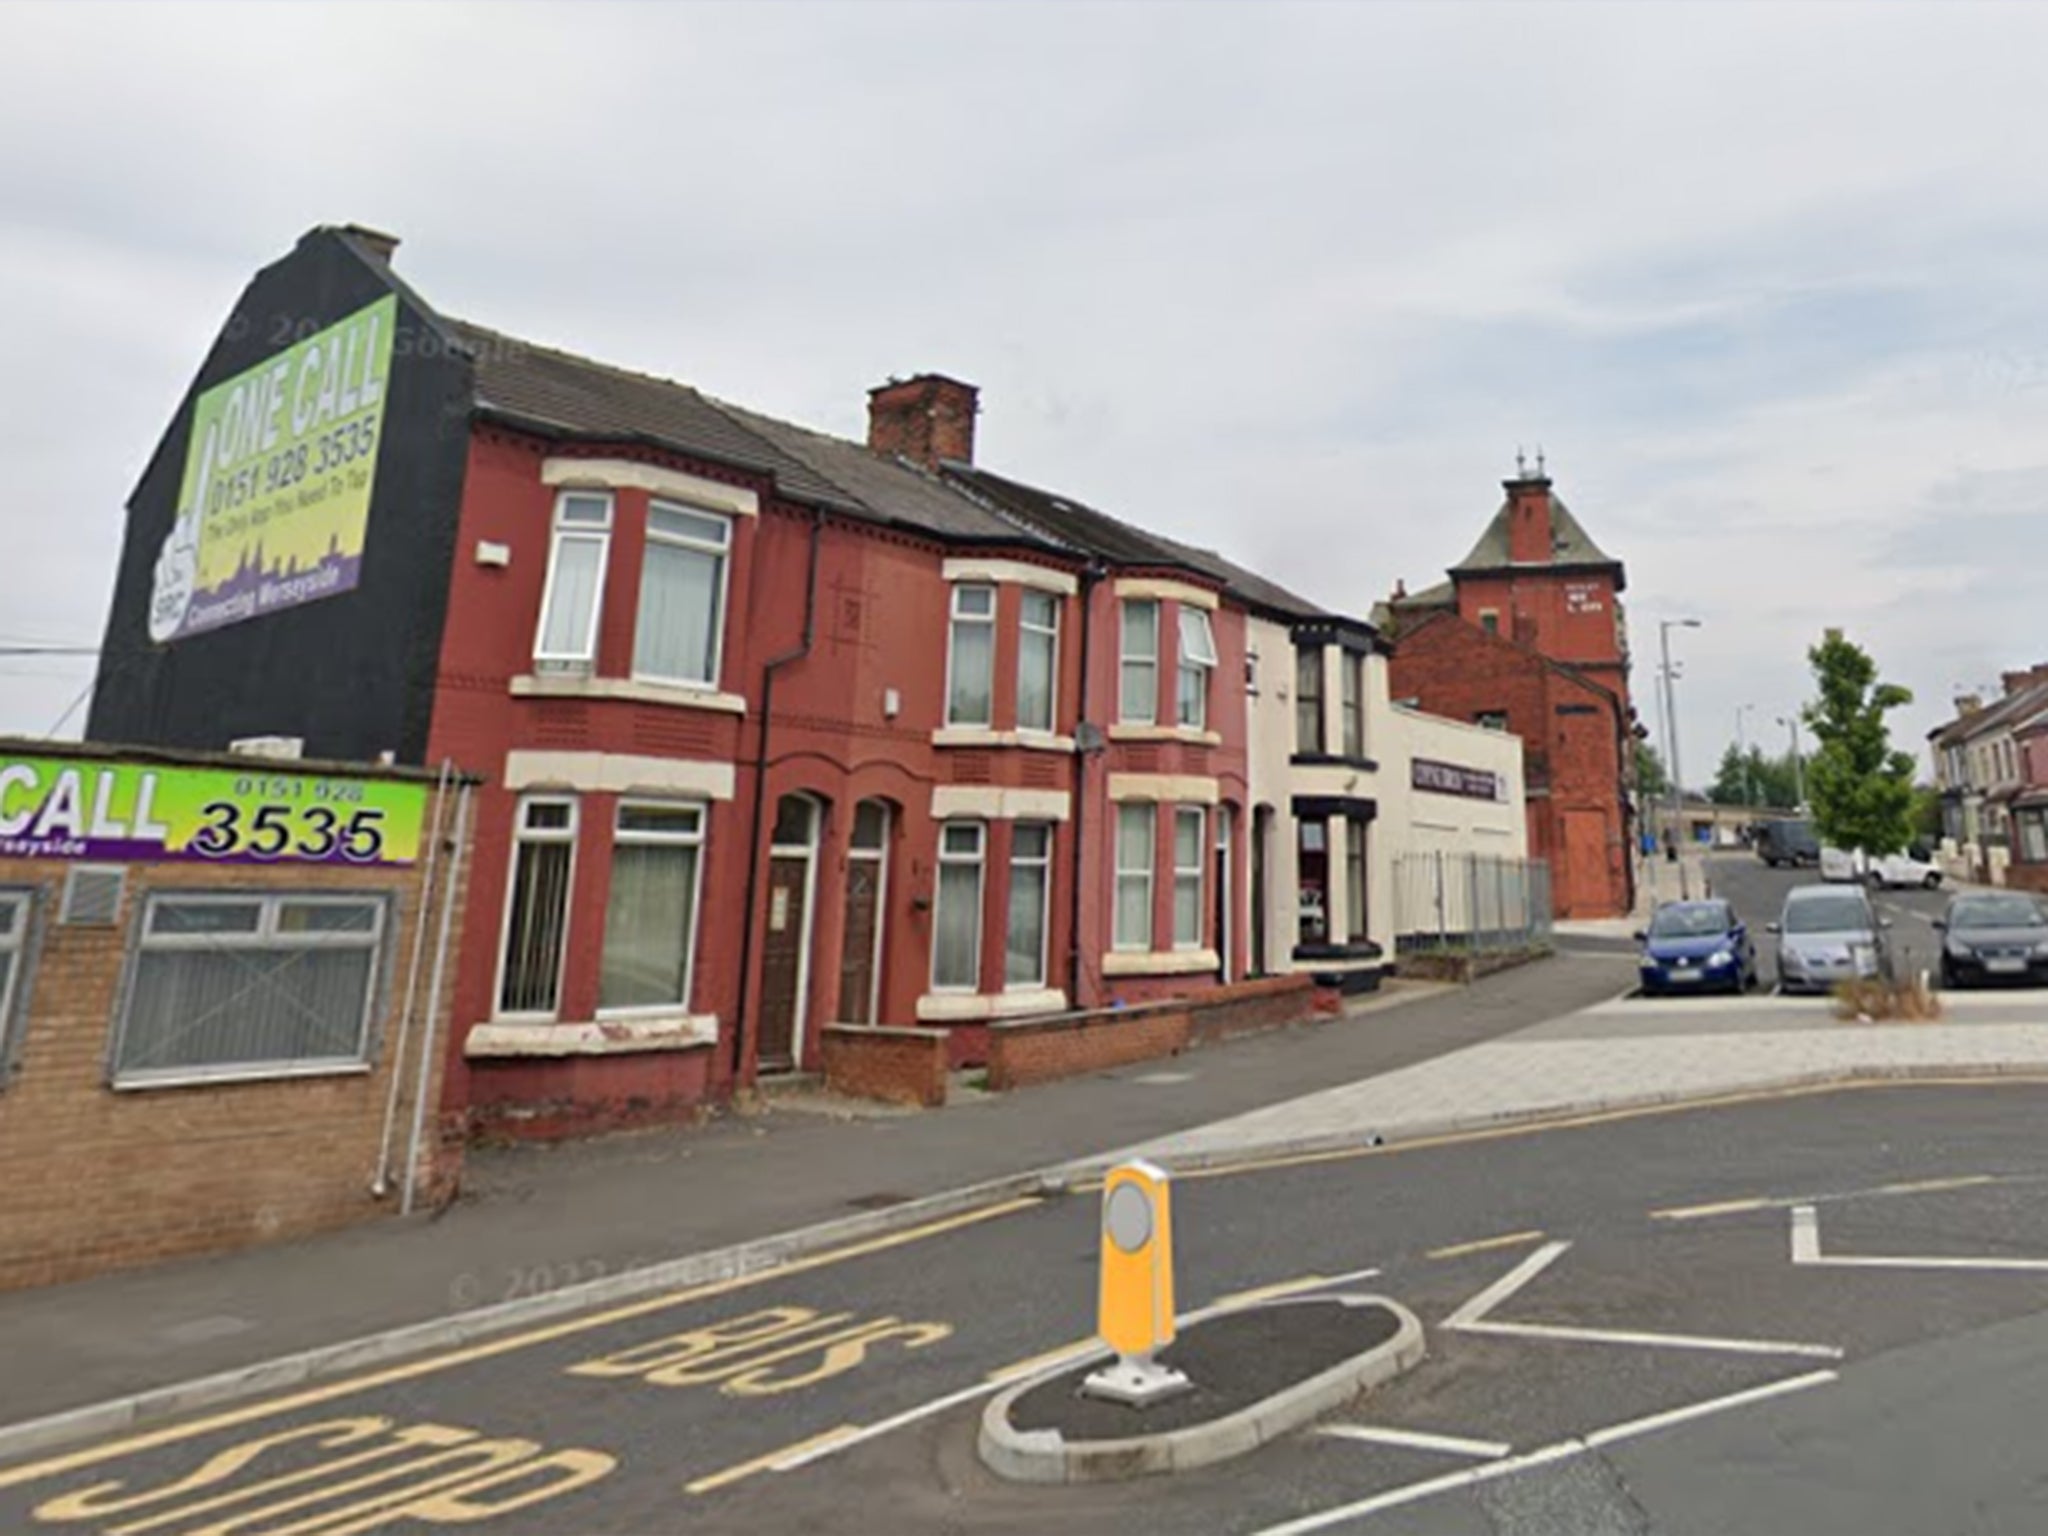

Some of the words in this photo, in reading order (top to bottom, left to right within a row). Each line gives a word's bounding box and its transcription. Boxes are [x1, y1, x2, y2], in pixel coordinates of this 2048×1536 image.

[217, 361, 291, 470] ONE
[290, 315, 382, 437] CALL
[210, 463, 260, 516] 0151
[264, 443, 309, 494] 928
[313, 414, 375, 475] 3535
[0, 765, 168, 840] CALL
[195, 802, 384, 860] 3535
[234, 776, 303, 798] 0151
[567, 1305, 954, 1396] BUS
[32, 1415, 617, 1536] STOP
